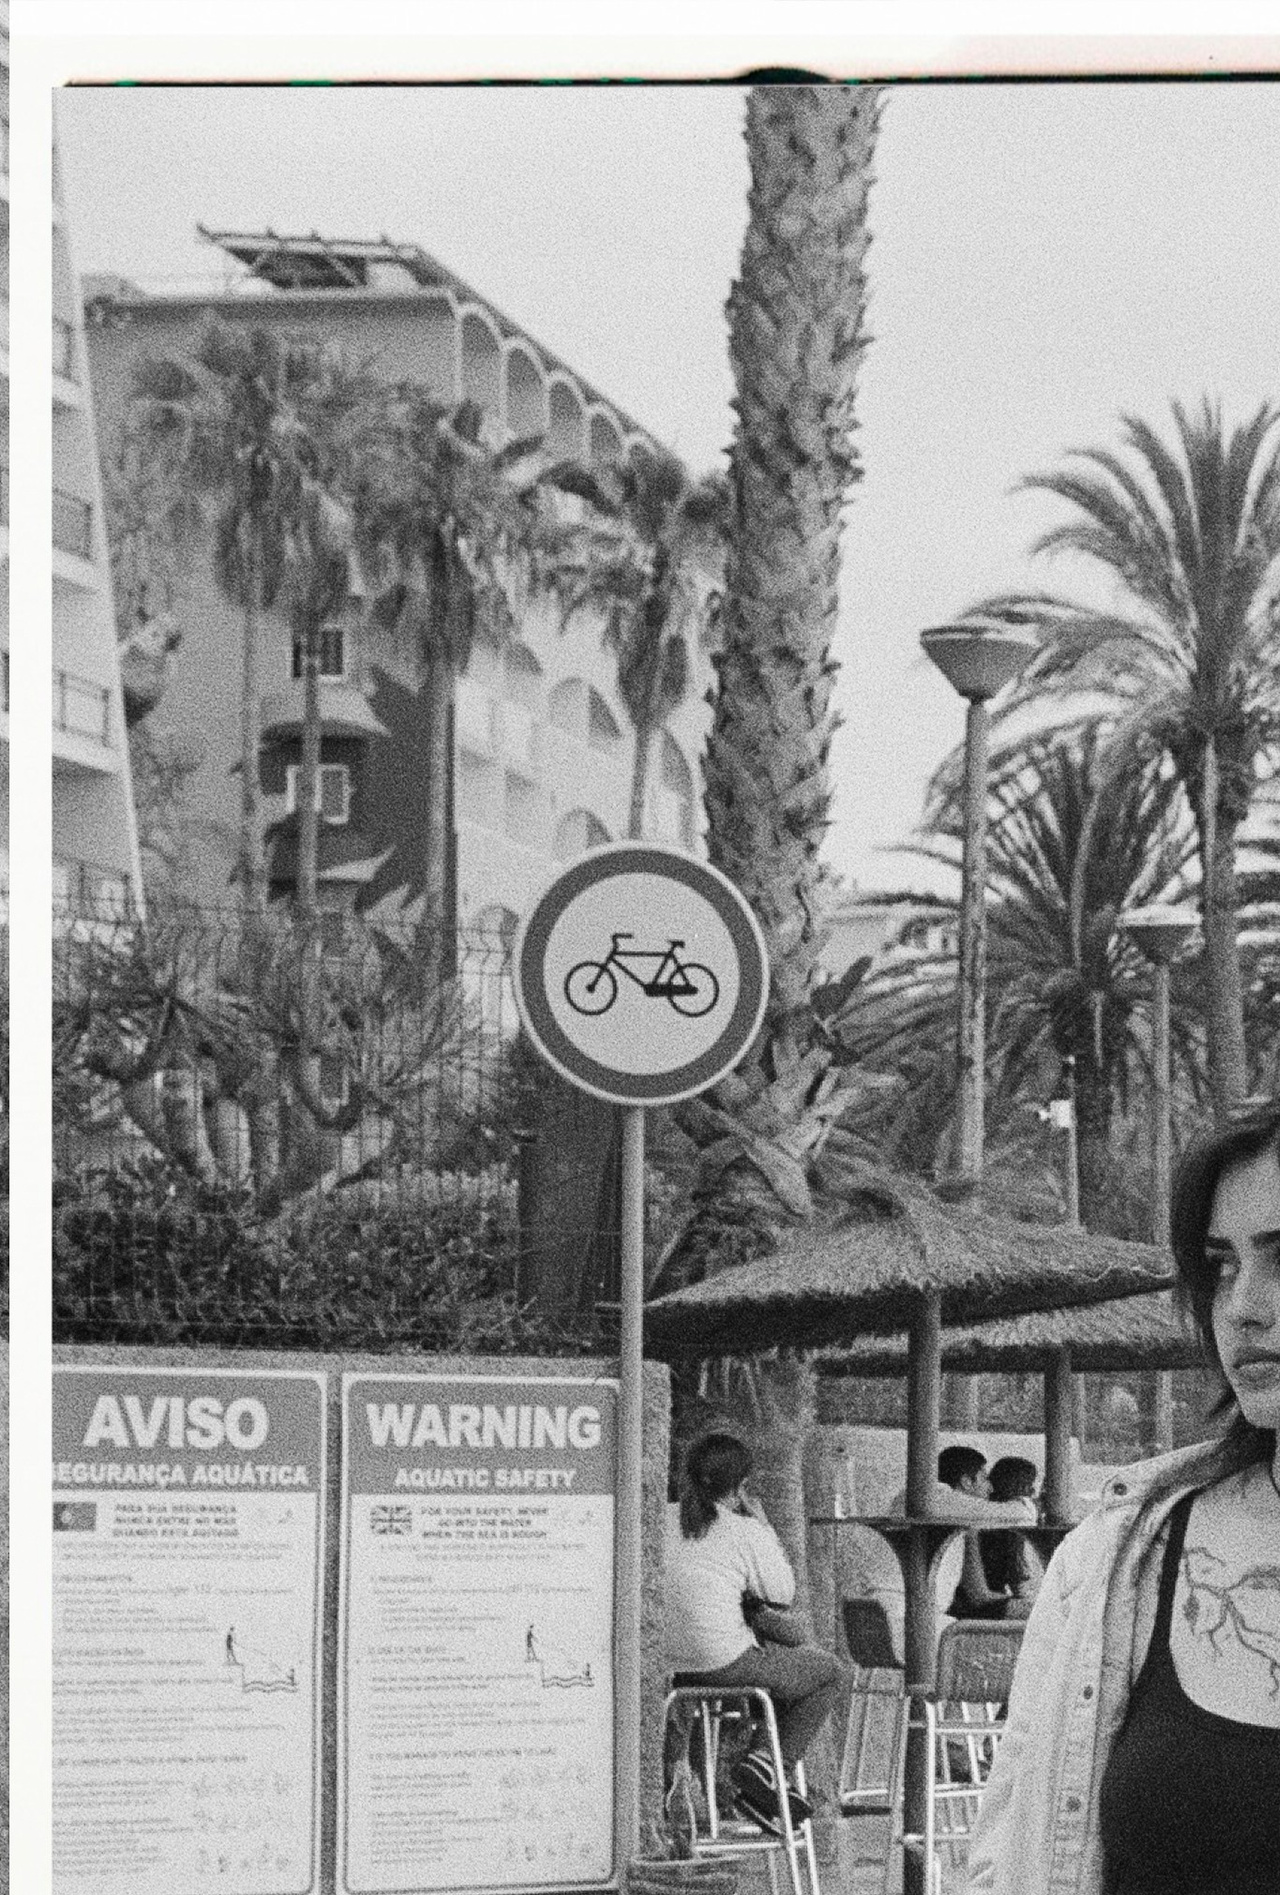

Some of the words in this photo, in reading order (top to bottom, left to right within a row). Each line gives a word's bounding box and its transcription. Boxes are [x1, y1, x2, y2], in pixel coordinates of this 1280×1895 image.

[82, 1395, 270, 1451] AVISO
[366, 1402, 602, 1450] WARNING
[192, 1460, 310, 1486] AQUÁTICA
[394, 1467, 490, 1488] AQUATIC
[494, 1468, 577, 1489] SAFETY
